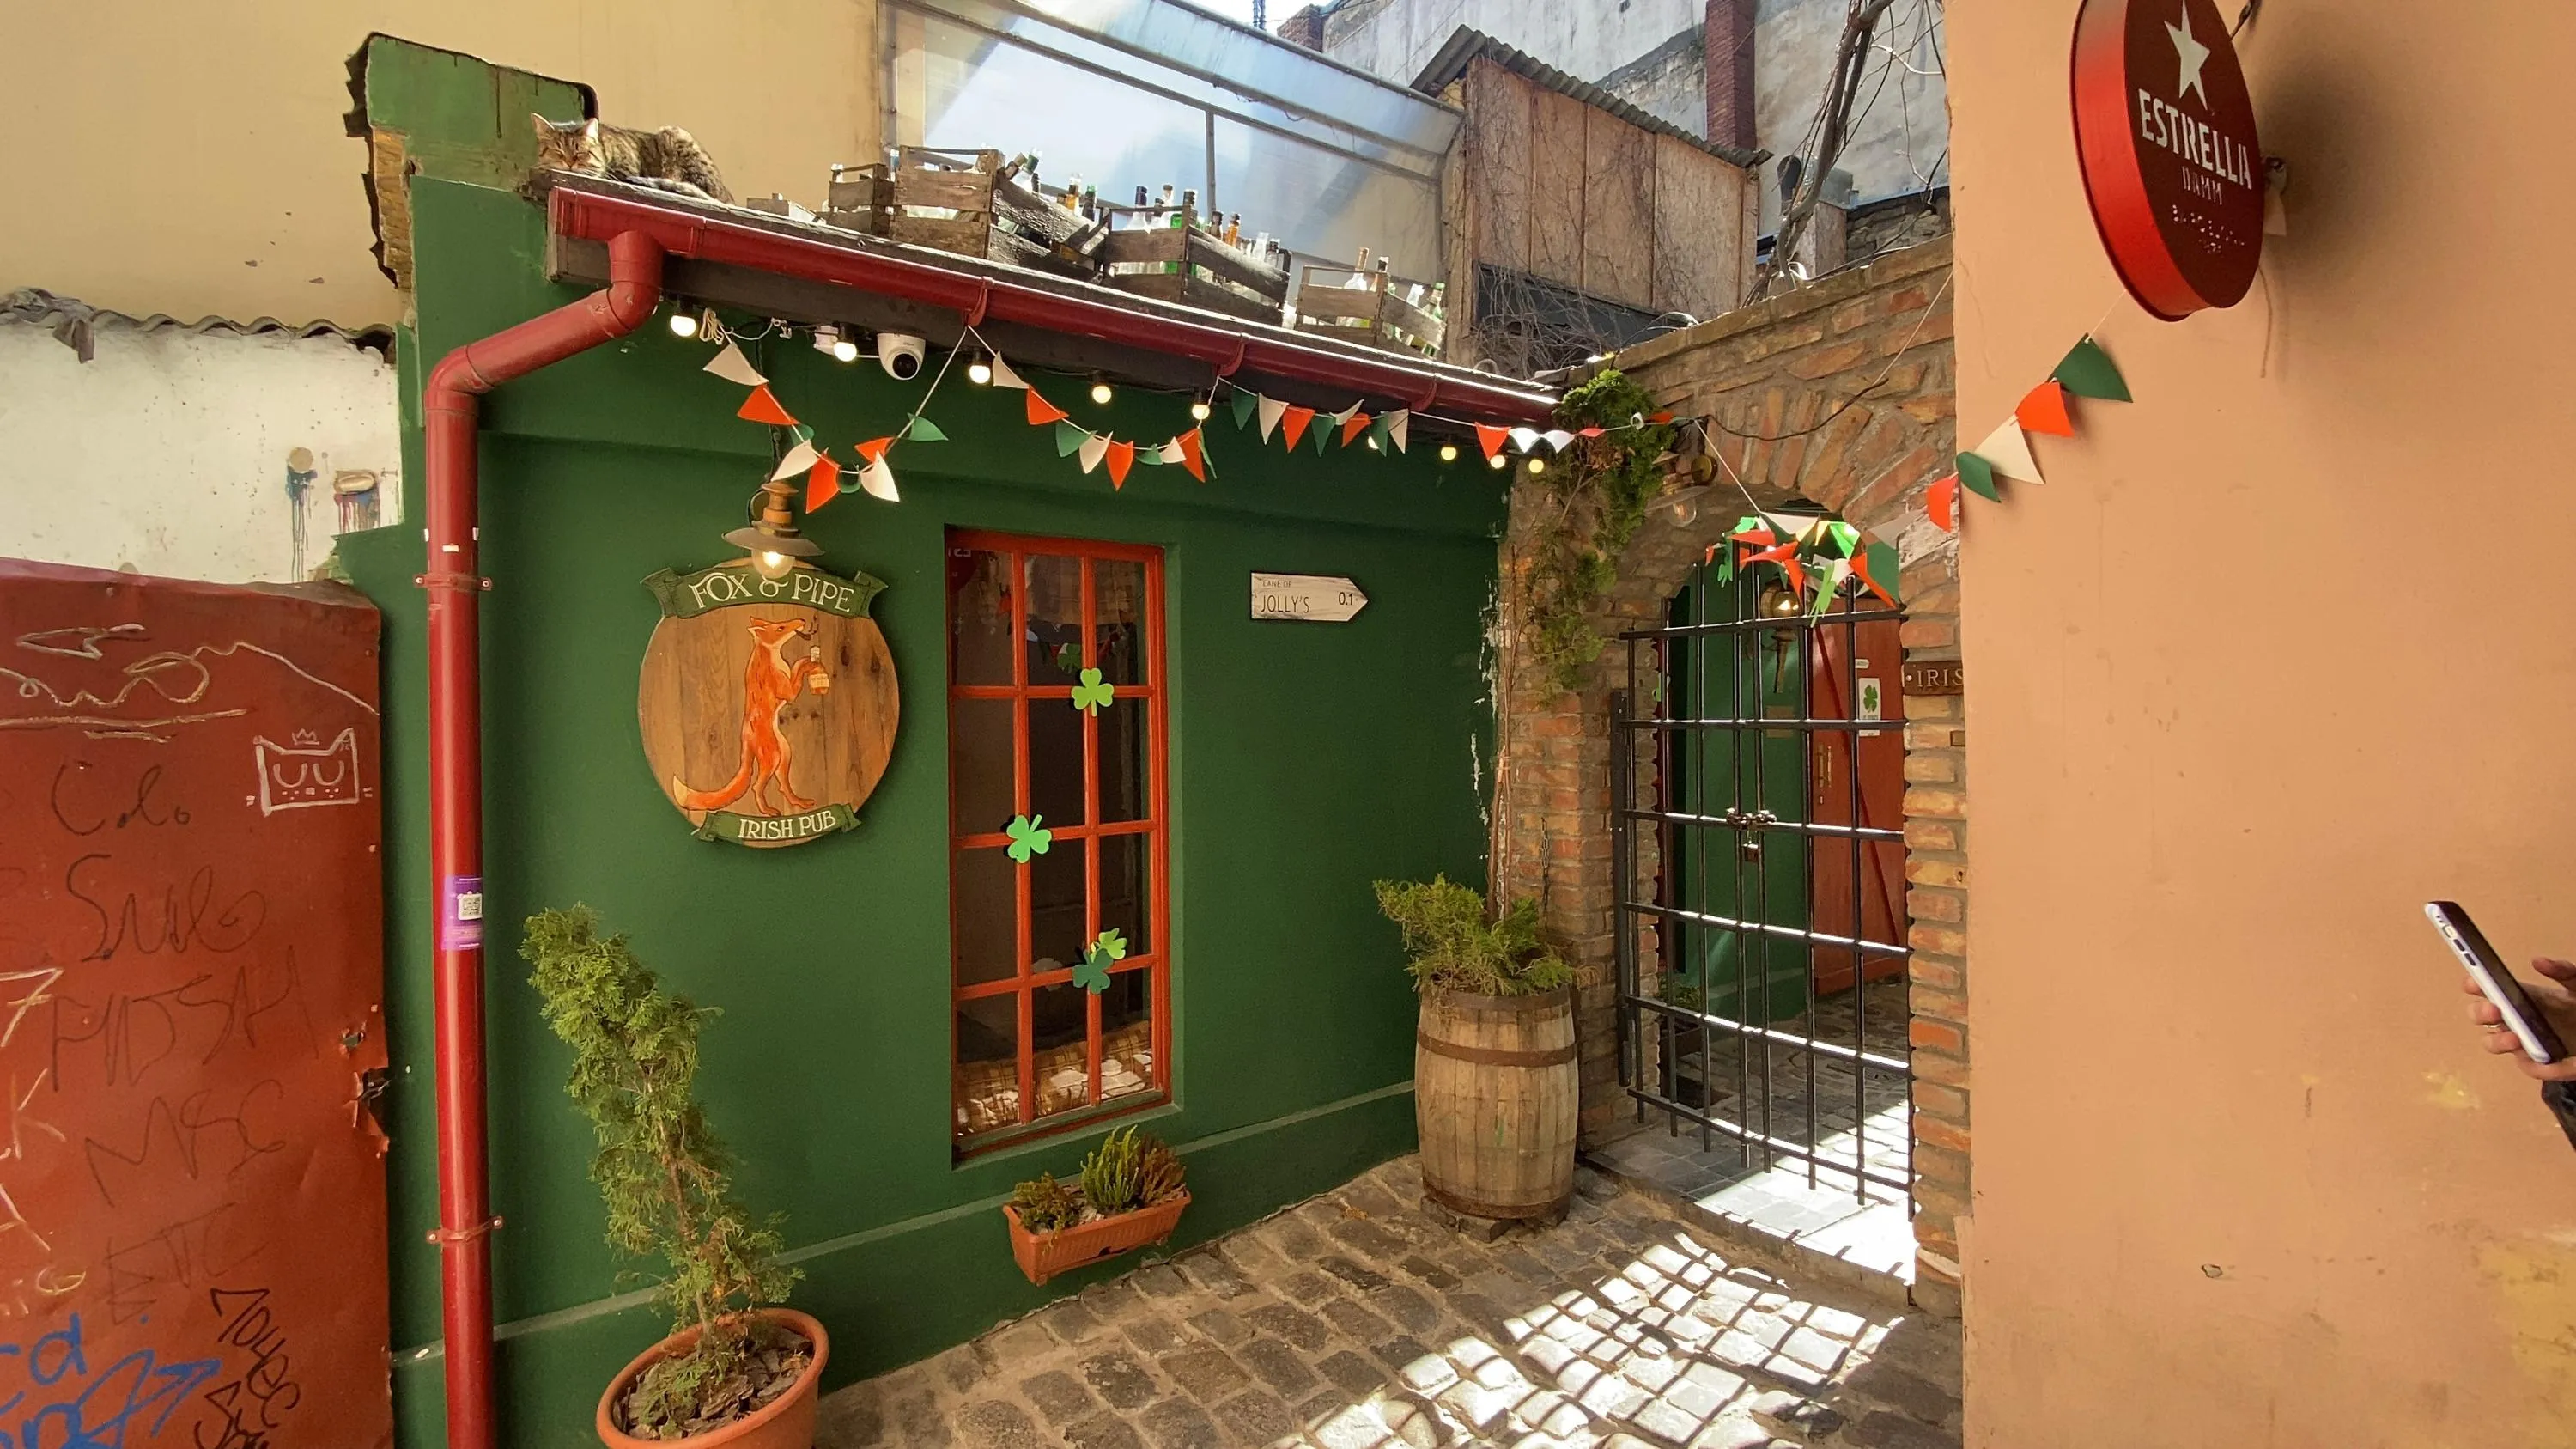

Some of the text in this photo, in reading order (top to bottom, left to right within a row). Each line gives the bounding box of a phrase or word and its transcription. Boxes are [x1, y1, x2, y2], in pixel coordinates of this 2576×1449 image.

[2138, 88, 2253, 190] ESTRELLA
[689, 572, 753, 609] FOX
[792, 574, 854, 612] PIPE
[1261, 591, 1353, 613] JOLLY'S 0.1
[738, 810, 836, 840] IRISH PUB
